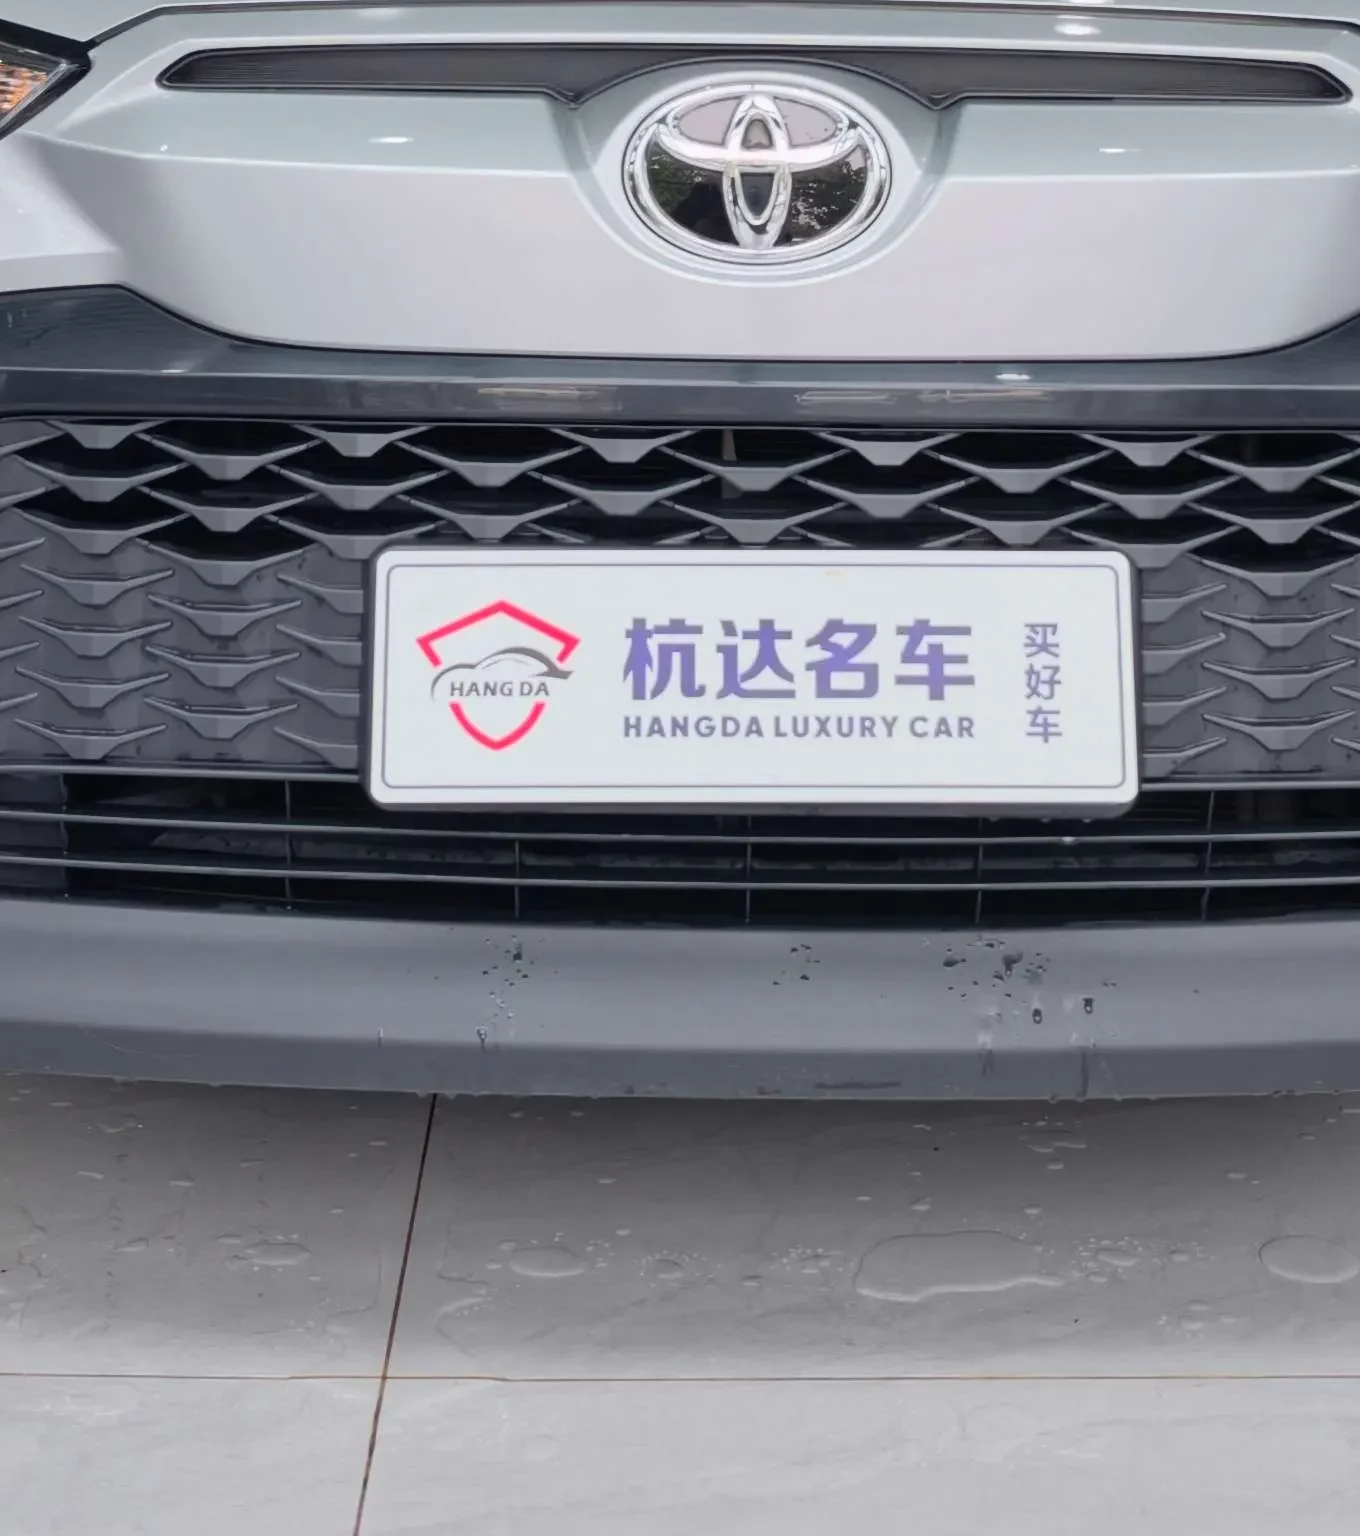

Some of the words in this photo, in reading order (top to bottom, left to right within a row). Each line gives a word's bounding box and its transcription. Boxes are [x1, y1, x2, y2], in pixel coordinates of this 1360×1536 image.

[623, 617, 976, 702] 杭达名车
[1023, 622, 1065, 745] 买好车
[449, 680, 514, 697] HANG
[519, 681, 550, 697] DA
[623, 715, 764, 739] HANGDA
[774, 715, 900, 739] LUXURY
[910, 715, 976, 739] CAR
